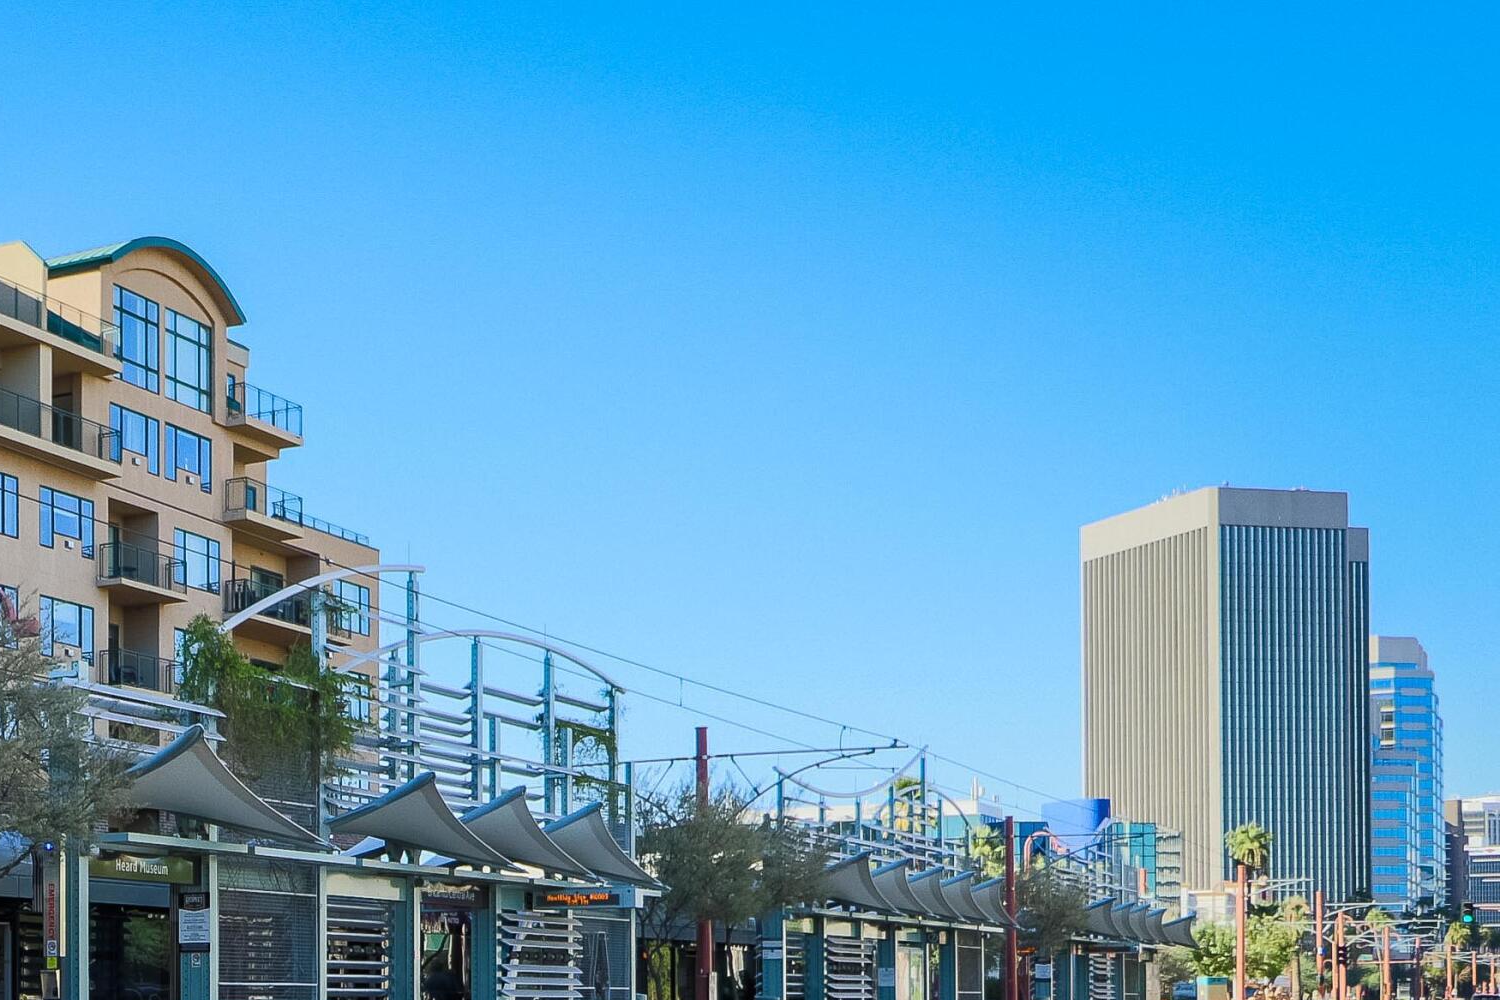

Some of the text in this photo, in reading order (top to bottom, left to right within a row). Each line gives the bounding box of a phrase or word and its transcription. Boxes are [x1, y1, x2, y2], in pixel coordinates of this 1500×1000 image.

[115, 859, 169, 876] Heard Museum
[48, 883, 56, 940] EMERGENCY
